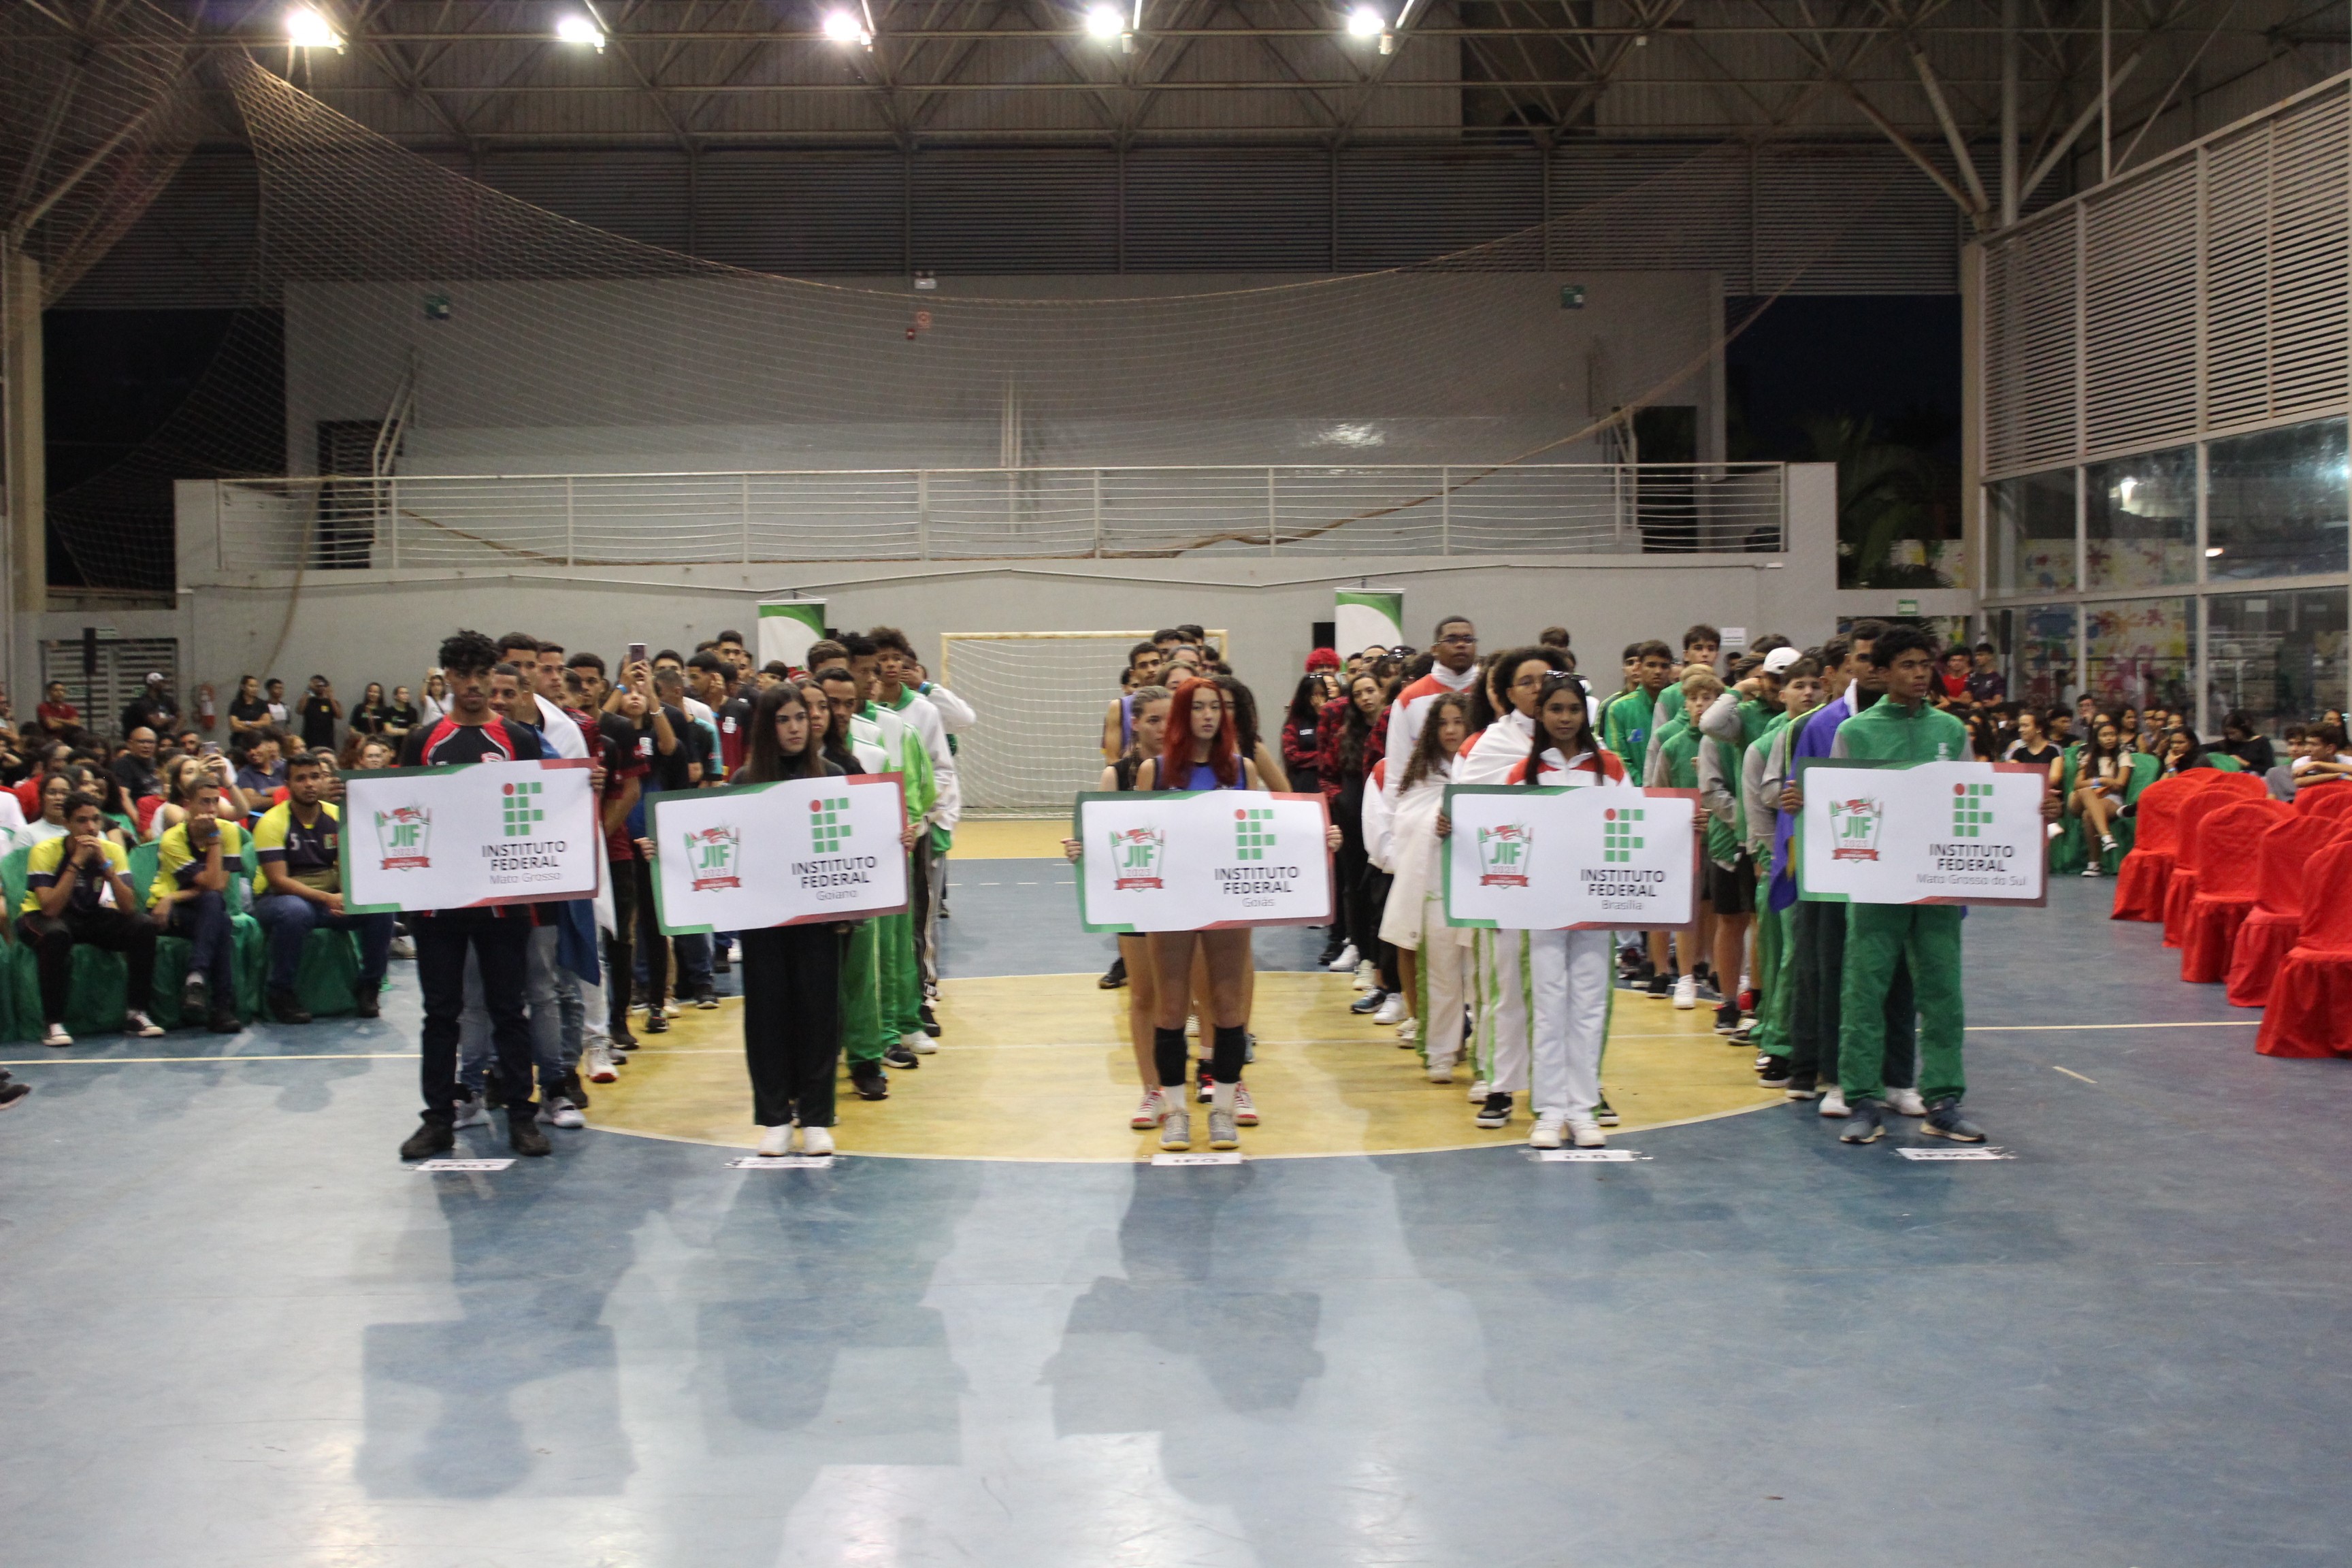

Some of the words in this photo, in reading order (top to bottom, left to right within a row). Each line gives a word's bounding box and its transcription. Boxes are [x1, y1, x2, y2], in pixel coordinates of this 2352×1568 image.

[1840, 817, 1872, 838] JIF
[389, 824, 420, 847] JIF
[482, 840, 567, 858] INSTITUTO
[699, 845, 730, 868] JIF
[1123, 845, 1154, 868] JIF
[1488, 842, 1522, 865] JIF
[1929, 844, 2016, 858] INSTITUTO
[491, 856, 560, 872] FEDERAL
[791, 856, 877, 875] INSTITUTO
[1938, 858, 2008, 872] FEDERAL
[489, 875, 519, 884] Mato
[521, 872, 561, 883] Grosso
[801, 871, 872, 889] FEDERAL
[1214, 866, 1301, 881] INSTITUTO
[1580, 869, 1666, 883] INSTITUTO
[1948, 874, 1988, 885] Grosso
[1991, 876, 2006, 885] do
[2008, 876, 2027, 886] Sul
[1223, 881, 1294, 894] FEDERAL
[1588, 884, 1657, 897] FEDERAL
[815, 890, 859, 901] Goiano
